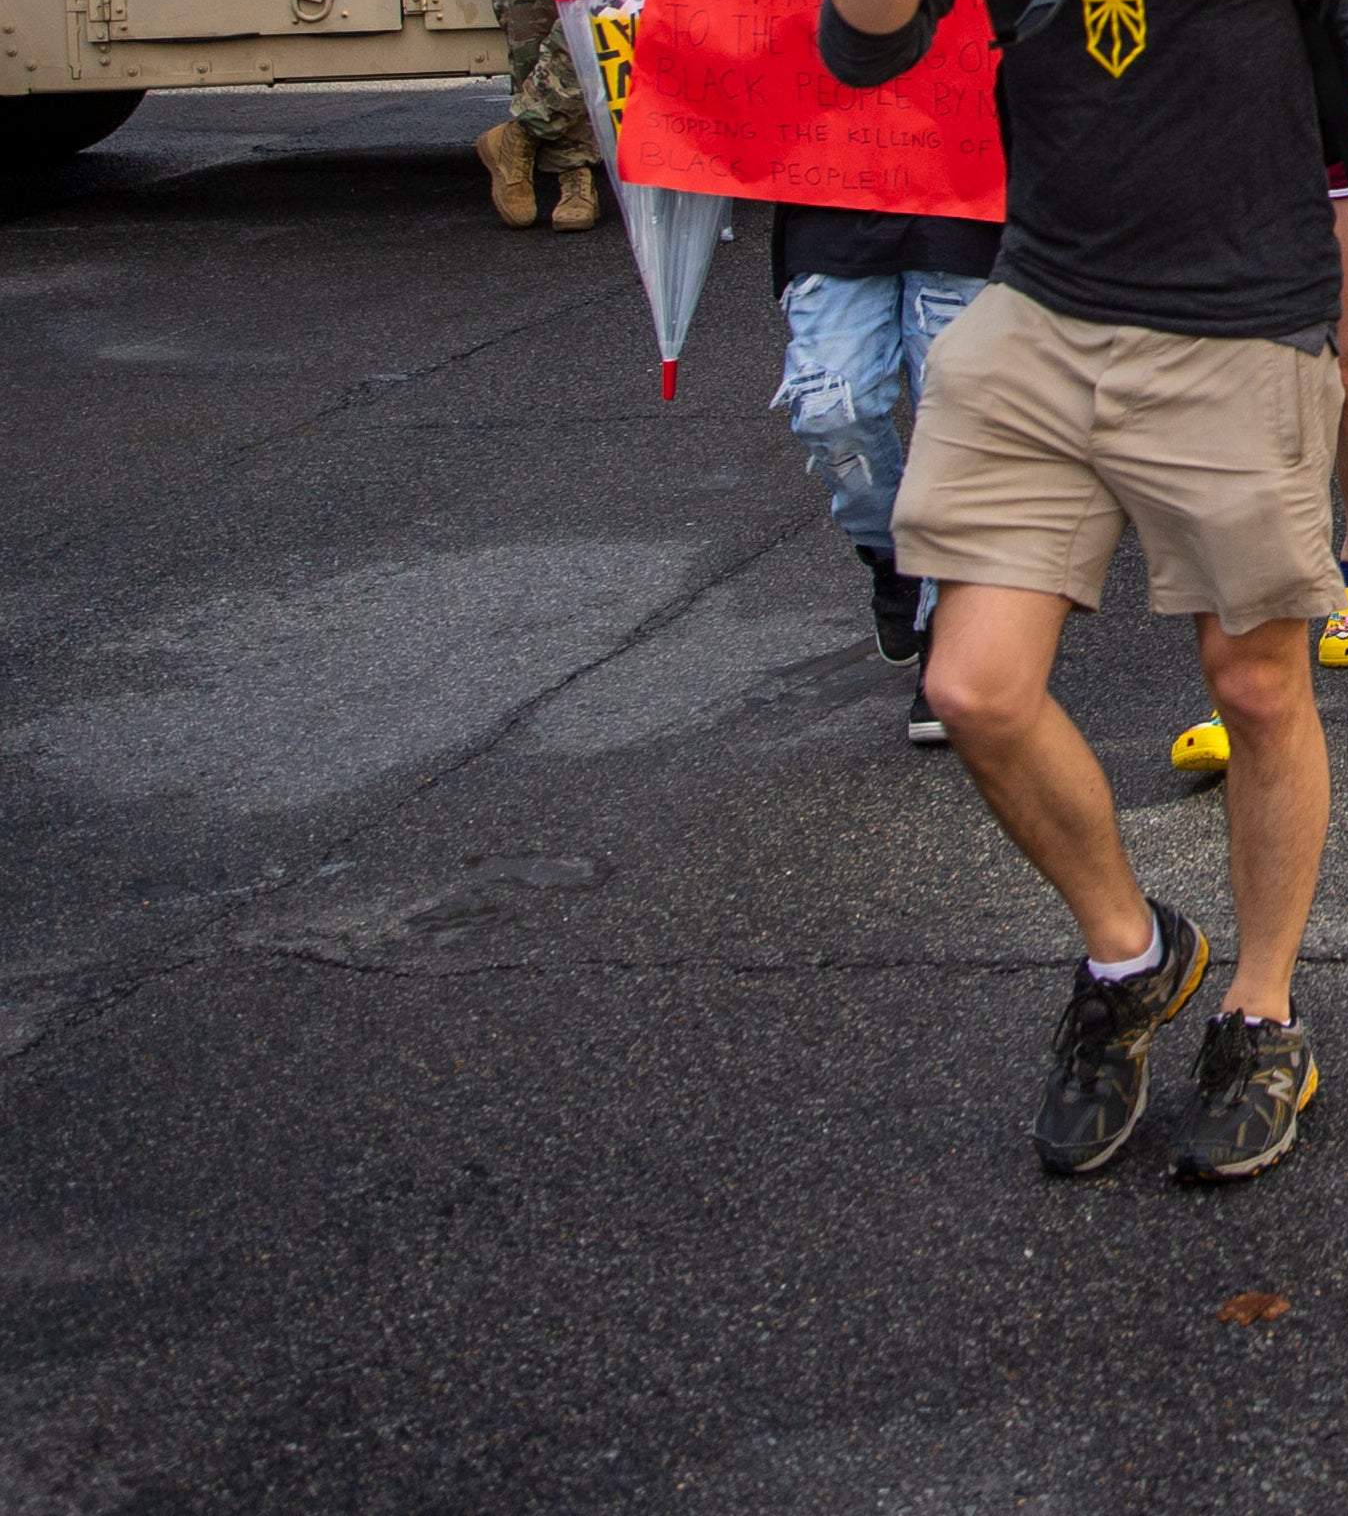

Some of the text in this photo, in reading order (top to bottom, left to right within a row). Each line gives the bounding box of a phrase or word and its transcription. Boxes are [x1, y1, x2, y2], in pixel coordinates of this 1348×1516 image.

[665, 3, 709, 48] TO
[734, 14, 784, 55] THE
[656, 56, 768, 107] BLACK
[796, 72, 912, 112] PEOPLE
[933, 81, 963, 117] BY
[646, 109, 993, 157] STOPPING THE KILLING OF
[640, 141, 750, 176] BLACK
